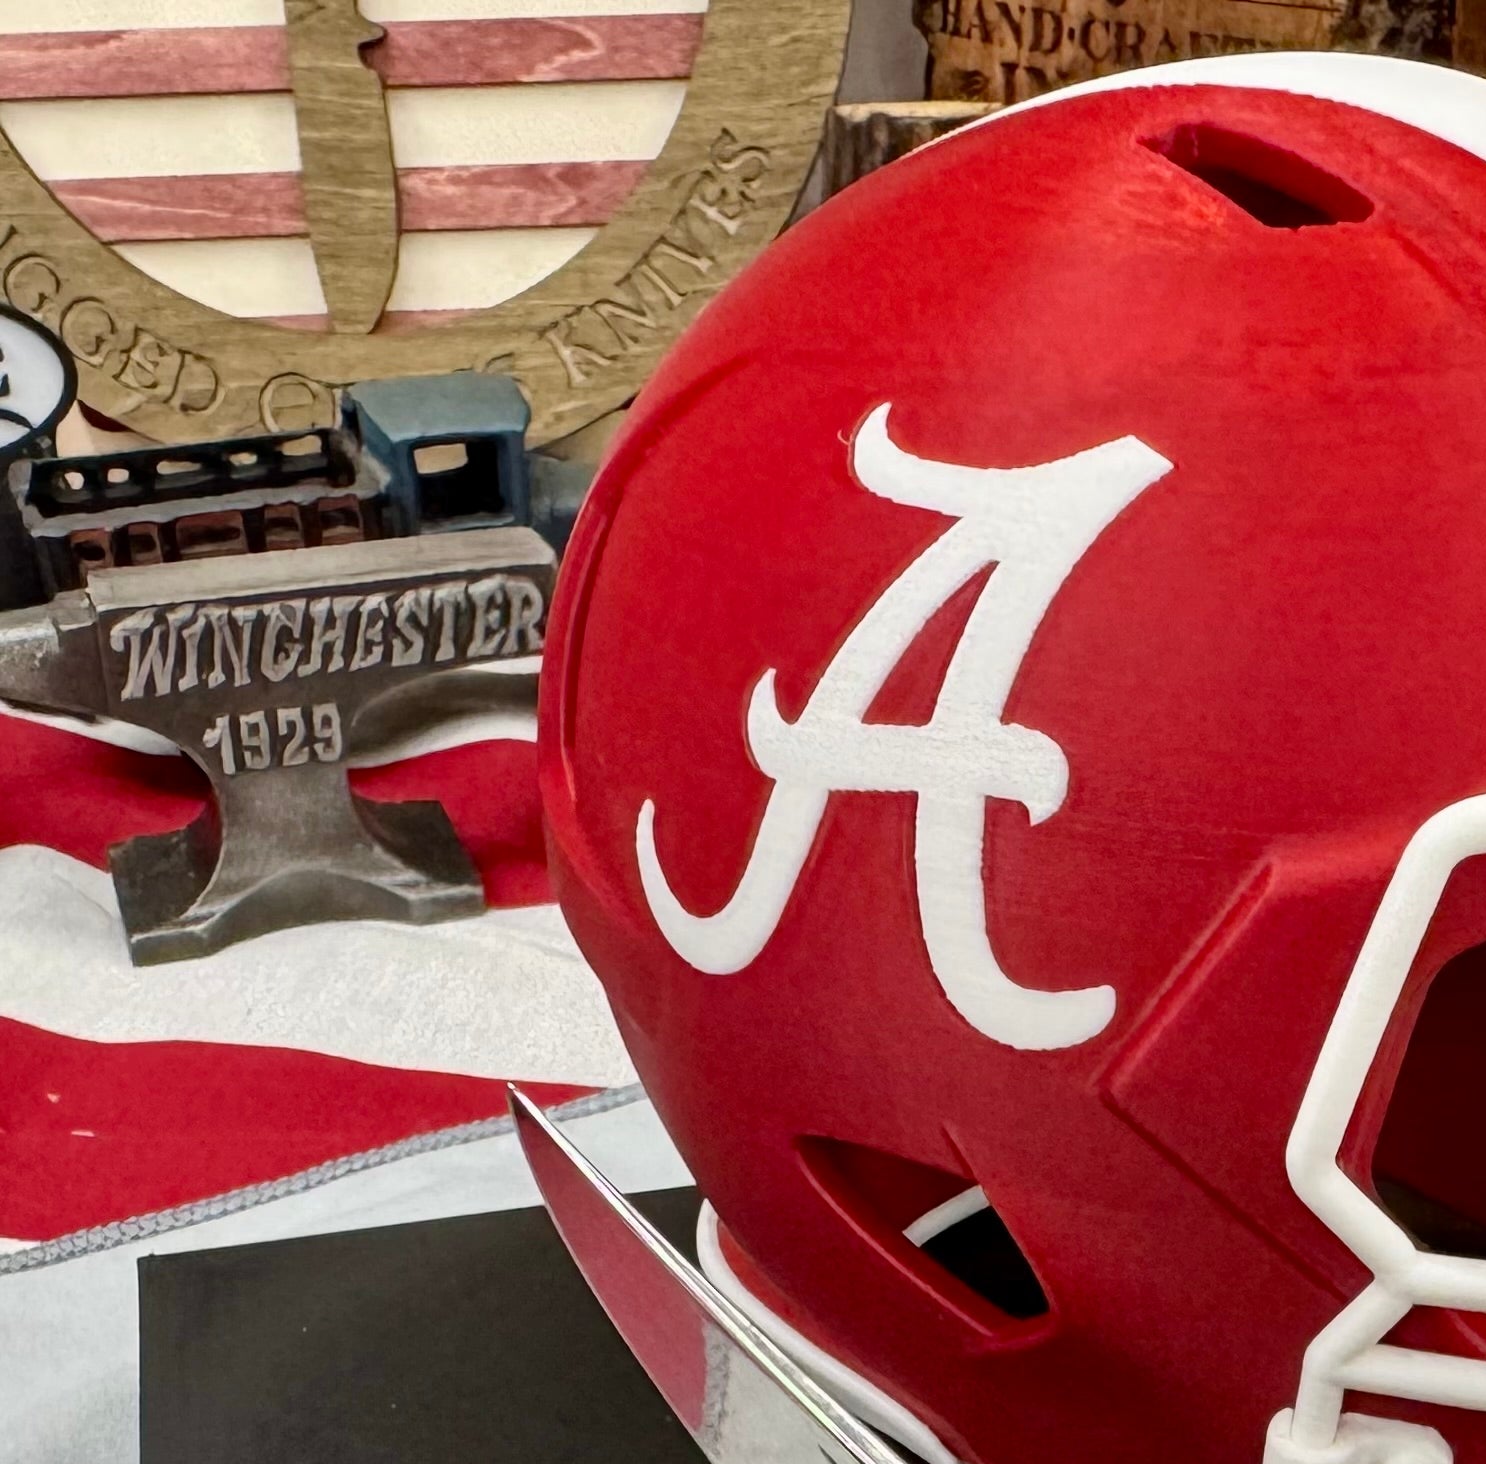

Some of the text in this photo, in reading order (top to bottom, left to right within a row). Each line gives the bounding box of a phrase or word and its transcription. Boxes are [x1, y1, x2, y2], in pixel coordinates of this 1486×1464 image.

[536, 127, 771, 387] KNIVES
[110, 574, 545, 702] WINCHESTER
[636, 401, 1175, 1050] A
[203, 702, 343, 775] 1929
